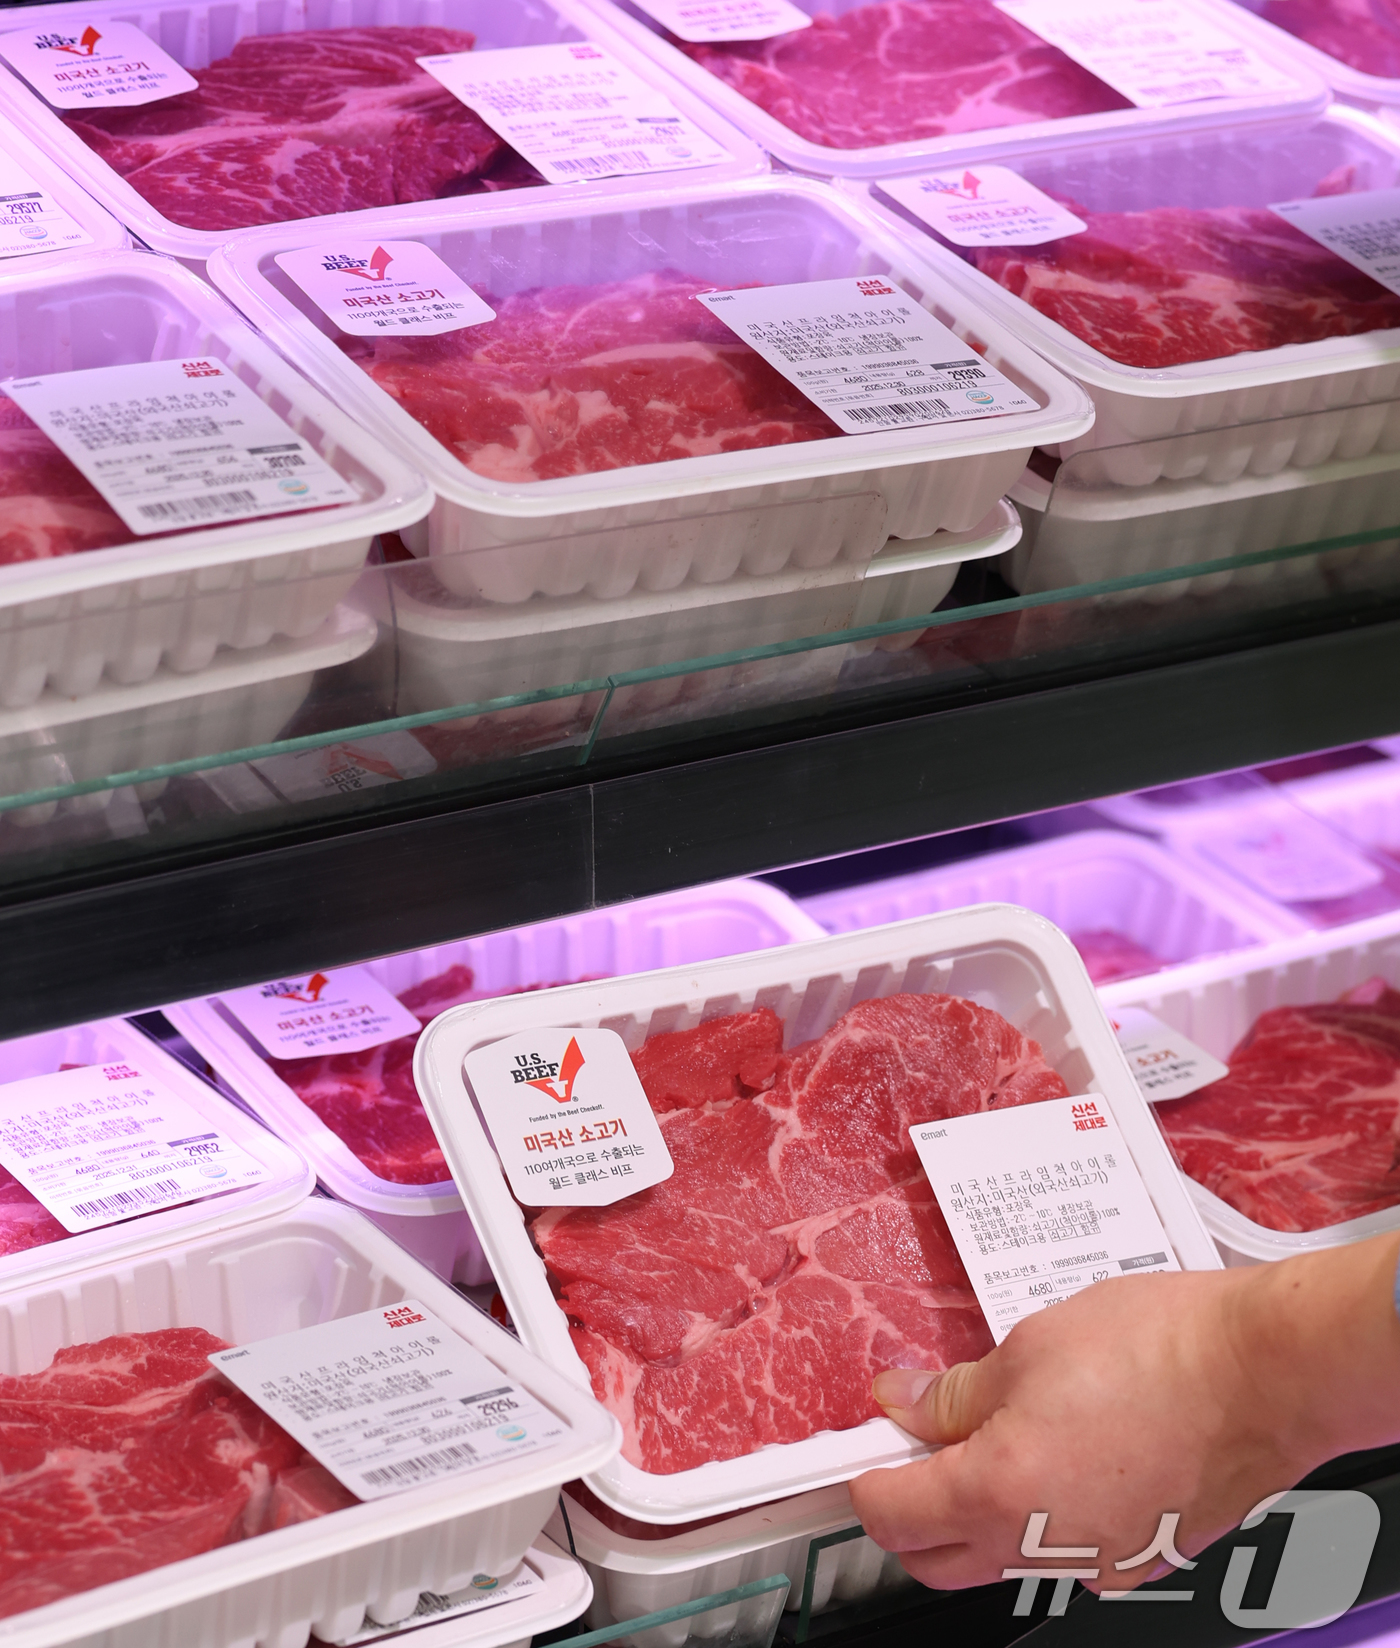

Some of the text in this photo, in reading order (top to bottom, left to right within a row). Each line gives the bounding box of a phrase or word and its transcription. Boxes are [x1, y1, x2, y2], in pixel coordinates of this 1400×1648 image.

[34, 36, 78, 49] BEEF
[53, 61, 150, 81] 미국산 소고기
[6, 202, 43, 214] 29577
[321, 259, 369, 271] BEEF
[323, 254, 355, 262] U.S.
[856, 279, 884, 289] 신선
[859, 287, 896, 296] 제대로
[342, 289, 446, 308] 미국산 소고기
[709, 295, 736, 303] emart
[347, 302, 465, 319] 110여개국으로 수출되는
[373, 312, 458, 327] 월드 클래스 비프
[181, 361, 213, 372] 신선
[843, 376, 868, 384] 4680
[948, 368, 986, 381] 29390
[861, 381, 906, 392] 2025.12.30
[897, 381, 978, 396] 803000106219
[277, 1016, 324, 1030] 미국산
[329, 1004, 374, 1020] 소고기
[514, 1053, 546, 1067] U.S.
[103, 1064, 132, 1074] 신선
[106, 1070, 142, 1081] 제대로
[510, 1062, 560, 1083] BEEF
[529, 1114, 549, 1123] Funded
[566, 1108, 579, 1116] Beef
[580, 1104, 605, 1113] Checkoff.
[1070, 1102, 1099, 1119] 신선
[1072, 1116, 1109, 1131] 제대로
[523, 1118, 628, 1153] 미국산 소고기
[920, 1128, 948, 1141] emart
[141, 1149, 160, 1159] 640
[184, 1142, 223, 1157] 29952
[524, 1144, 645, 1175] 110여개국으로 수출되는
[75, 1164, 101, 1176] 4680
[93, 1164, 138, 1180] 2025.12.31
[129, 1156, 213, 1180] 803000106219
[548, 1164, 635, 1190] 월드 클래스 비프
[191, 1178, 237, 1193] 02)380-5678
[950, 1171, 1109, 1213] 원산지:미국산(외국산쇠고기)
[965, 1199, 1034, 1221] 식품유형:포장육
[1057, 1199, 1093, 1216] 냉장보관
[979, 1232, 1047, 1256] 용도:스테이크용
[984, 1250, 1109, 1285] 품목보고번호 1999036845036
[1132, 1257, 1155, 1267] 가격(원)
[1055, 1275, 1082, 1286] 내용량(g)
[987, 1282, 1053, 1300] 100g(원) 4680
[383, 1306, 415, 1321] 신선
[995, 1306, 1019, 1317] 소비기한
[386, 1313, 427, 1329] 제대로
[220, 1350, 251, 1362] emart
[478, 1398, 519, 1417] 29296
